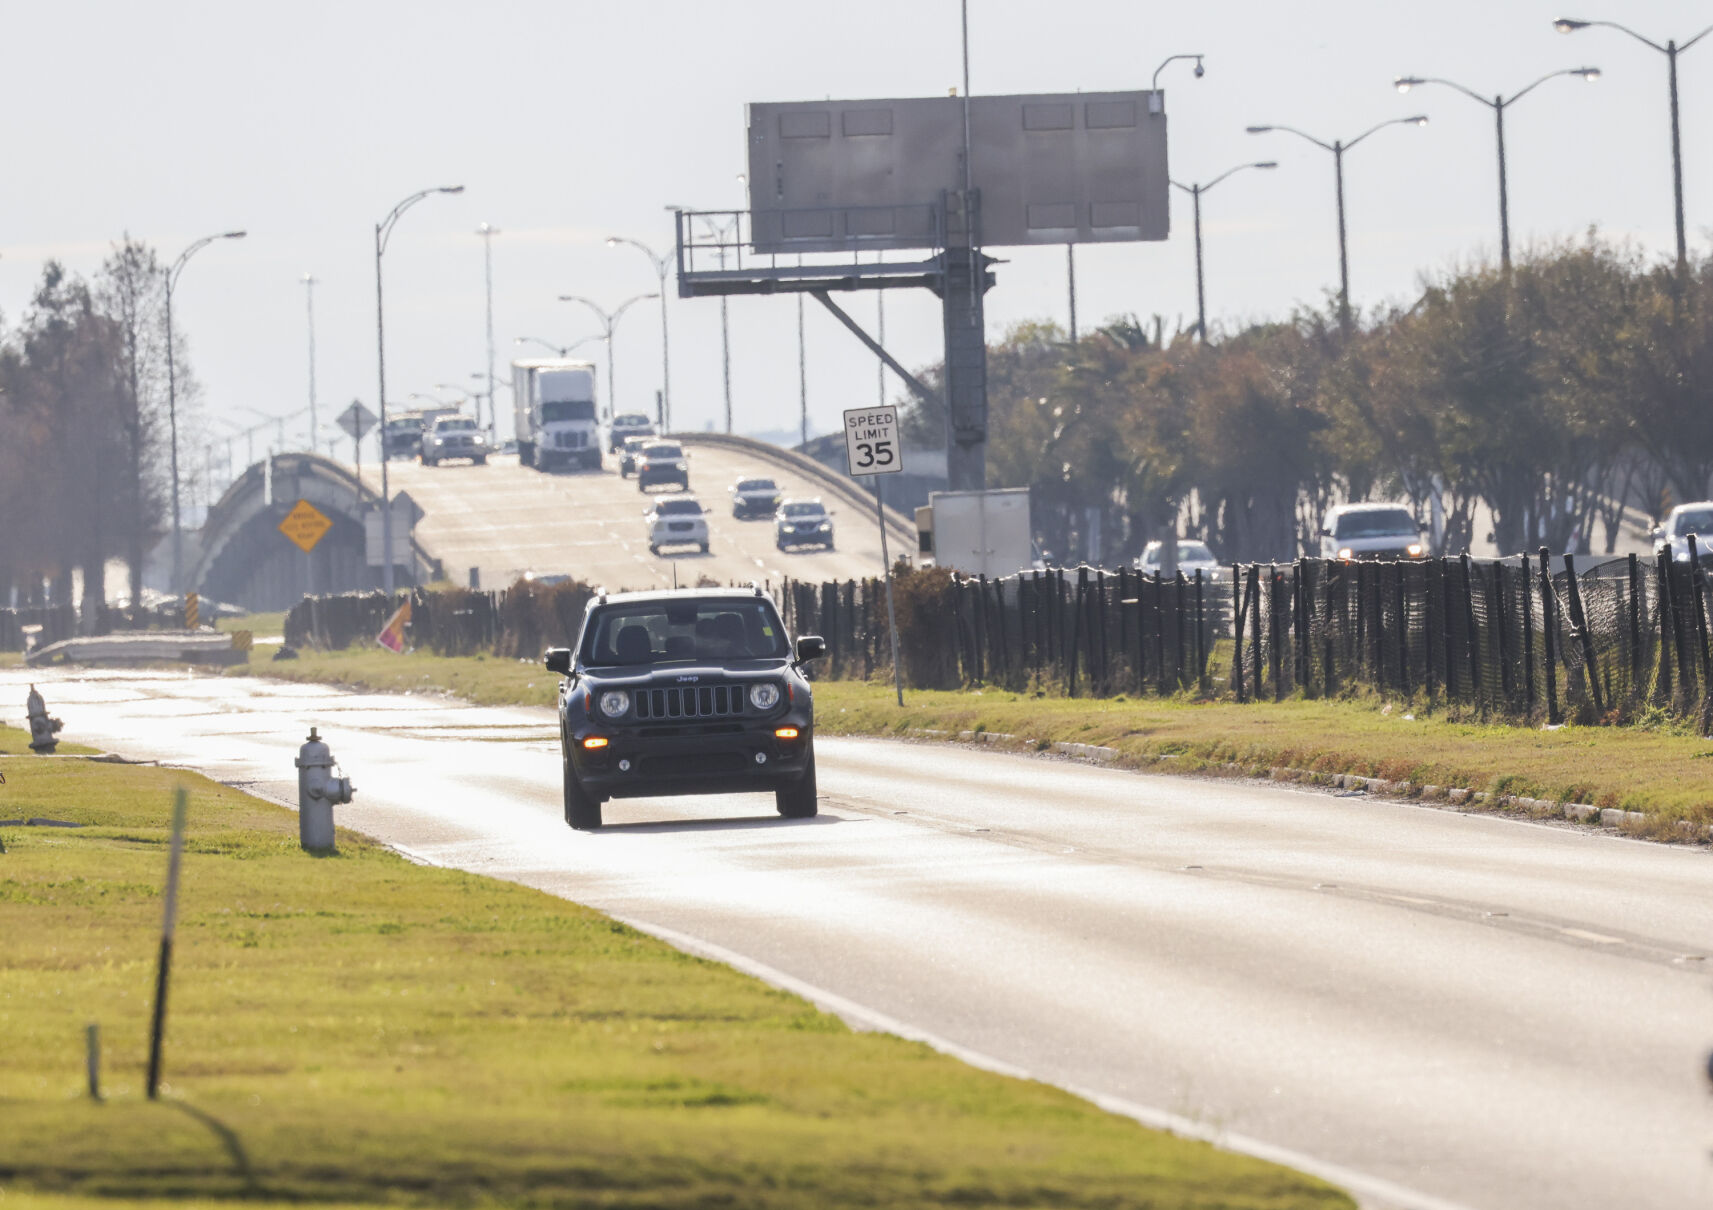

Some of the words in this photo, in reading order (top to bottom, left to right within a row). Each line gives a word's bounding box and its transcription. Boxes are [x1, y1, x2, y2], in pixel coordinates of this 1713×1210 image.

[848, 413, 893, 428] SPEED
[855, 428, 888, 441] LIMIT
[856, 441, 893, 468] 35
